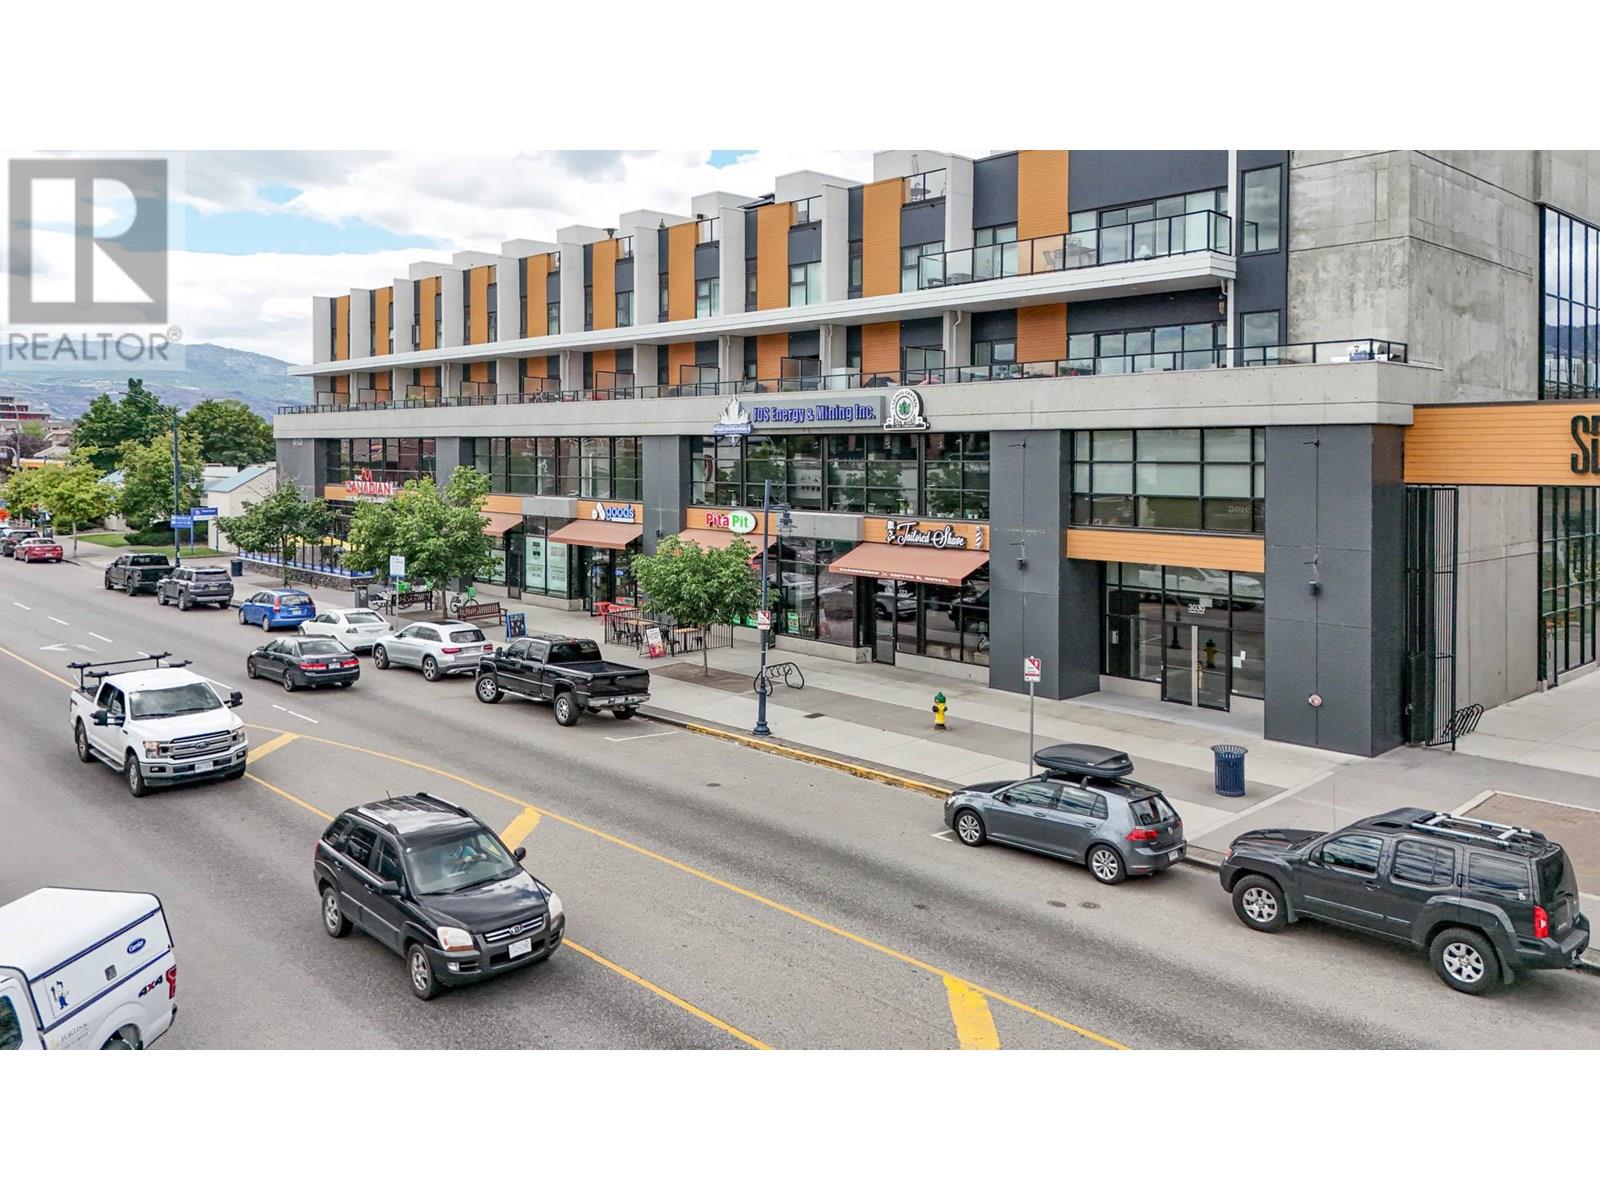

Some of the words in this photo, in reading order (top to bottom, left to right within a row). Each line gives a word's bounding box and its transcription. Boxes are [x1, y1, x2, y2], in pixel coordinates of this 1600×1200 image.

[771, 407, 805, 423] Energy
[806, 408, 814, 421] &
[815, 405, 853, 422] Mining
[854, 404, 876, 420] Inc.
[345, 480, 393, 496] CANADIAN
[705, 511, 729, 527] Pita
[732, 514, 748, 528] Pit
[897, 521, 931, 545] Tailored
[931, 525, 965, 548] Shave
